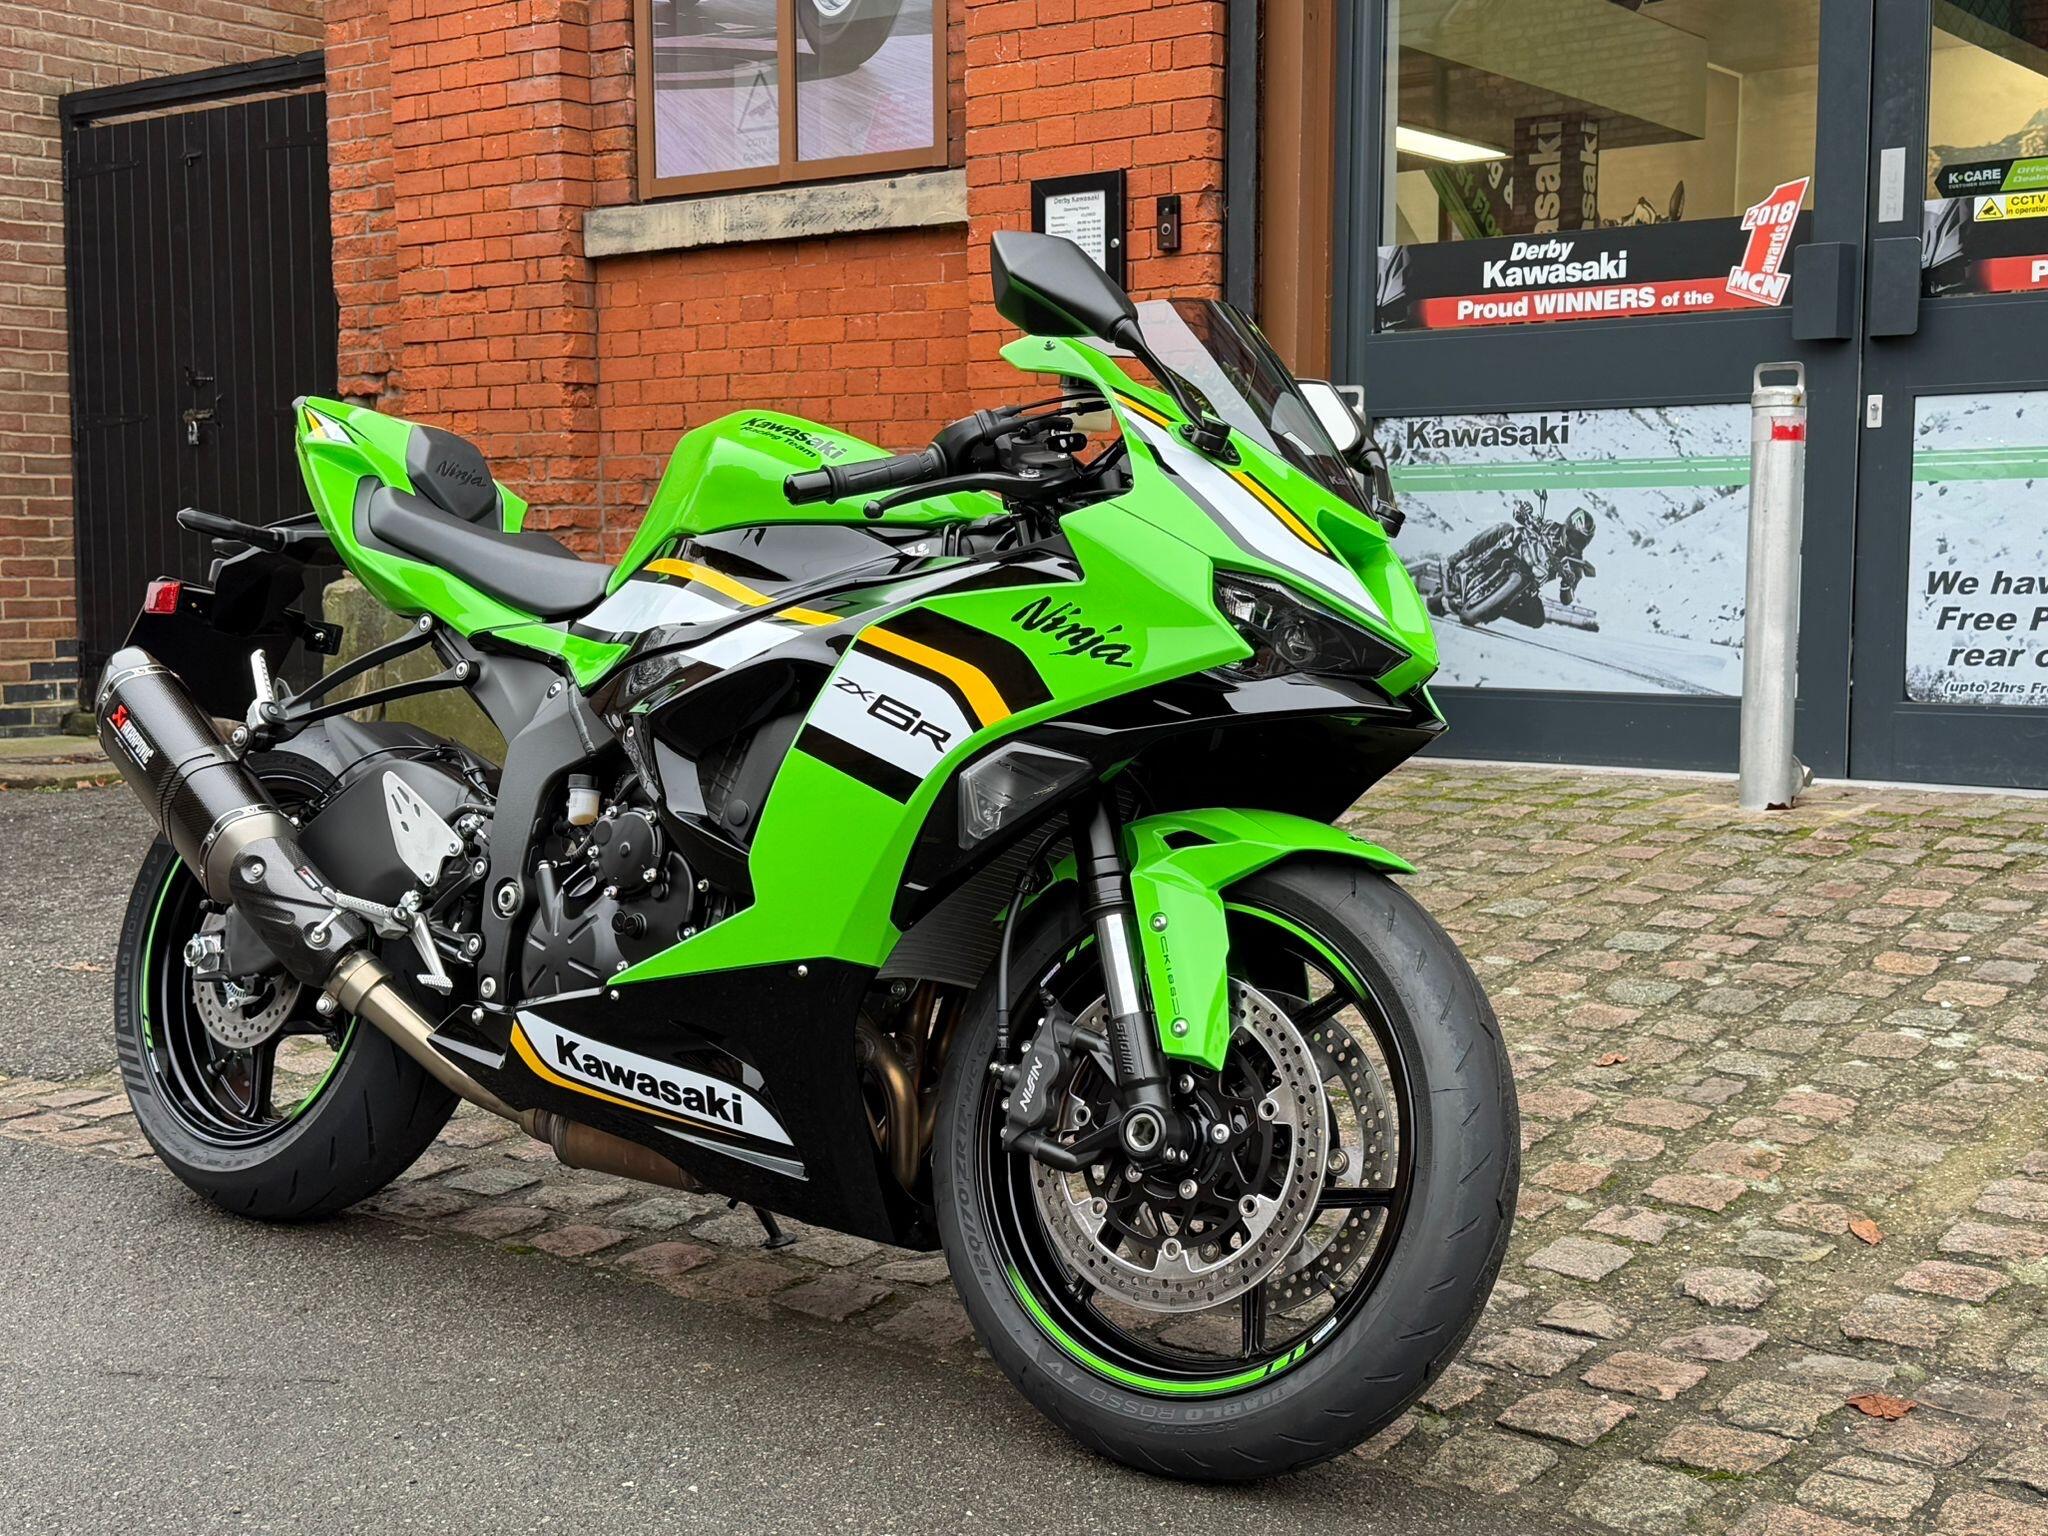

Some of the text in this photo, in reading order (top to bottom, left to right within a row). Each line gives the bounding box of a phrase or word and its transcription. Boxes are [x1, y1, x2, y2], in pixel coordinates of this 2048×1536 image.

[1746, 200, 1796, 228] 2018
[2011, 194, 2046, 206] CCTV
[1510, 239, 1575, 262] Derby
[1762, 224, 1789, 273] awards
[1483, 250, 1628, 288] Kawasaki
[1731, 269, 1785, 299] MCN
[1458, 295, 1529, 321] Proud
[1534, 286, 1656, 316] WINNERS
[1661, 292, 1681, 308] of
[1683, 290, 1714, 306] the
[740, 417, 848, 460] Kawasaki
[784, 438, 817, 458] Team
[1406, 415, 1570, 450] Kawasaki
[435, 460, 488, 488] Ninja
[1927, 571, 1979, 595] We
[1010, 596, 1133, 668] Ninja
[1936, 606, 2018, 631] Free
[1947, 648, 2026, 667] rear
[1989, 681, 2026, 693] 2hrs
[832, 676, 952, 754] ZX-6R
[555, 1034, 744, 1126] Kawasaki
[1020, 1056, 1043, 1113] NISSIN
[1089, 1386, 1177, 1420] ROSSO
